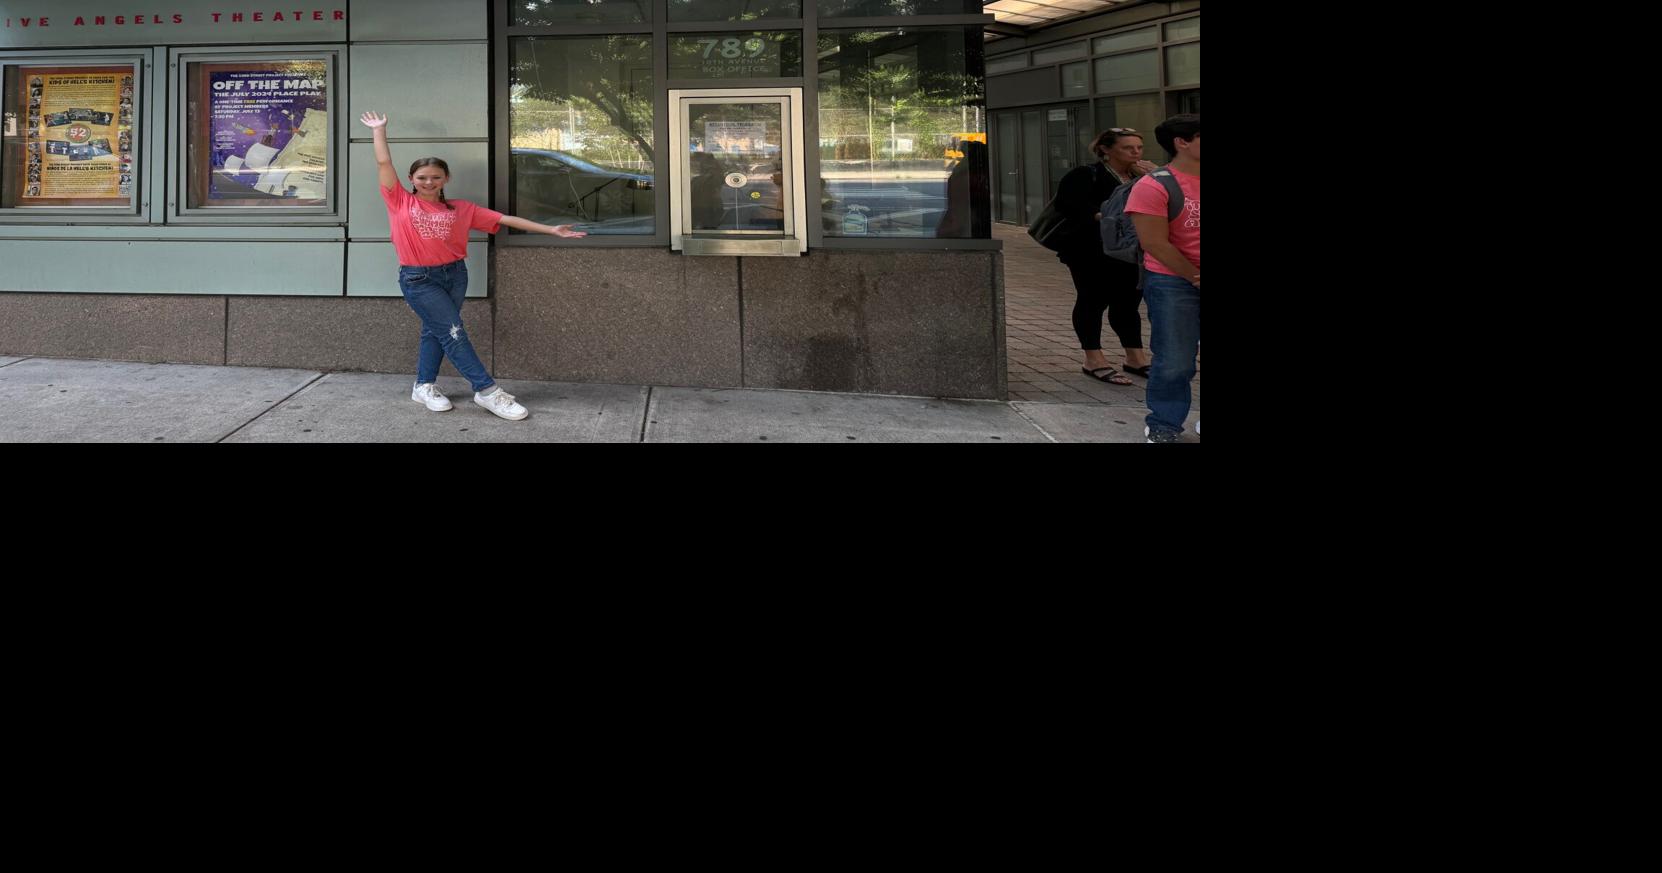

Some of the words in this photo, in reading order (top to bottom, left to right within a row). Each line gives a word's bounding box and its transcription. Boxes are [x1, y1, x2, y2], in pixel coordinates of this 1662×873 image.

[73, 14, 183, 26] ANGELS
[211, 10, 345, 23] THEATER
[697, 38, 765, 58] 789
[702, 65, 724, 73] BOX
[727, 65, 769, 73] OFFICE
[212, 80, 244, 90] OFF
[247, 79, 280, 90] THE
[283, 79, 325, 90] MAP
[70, 127, 87, 139] 52
